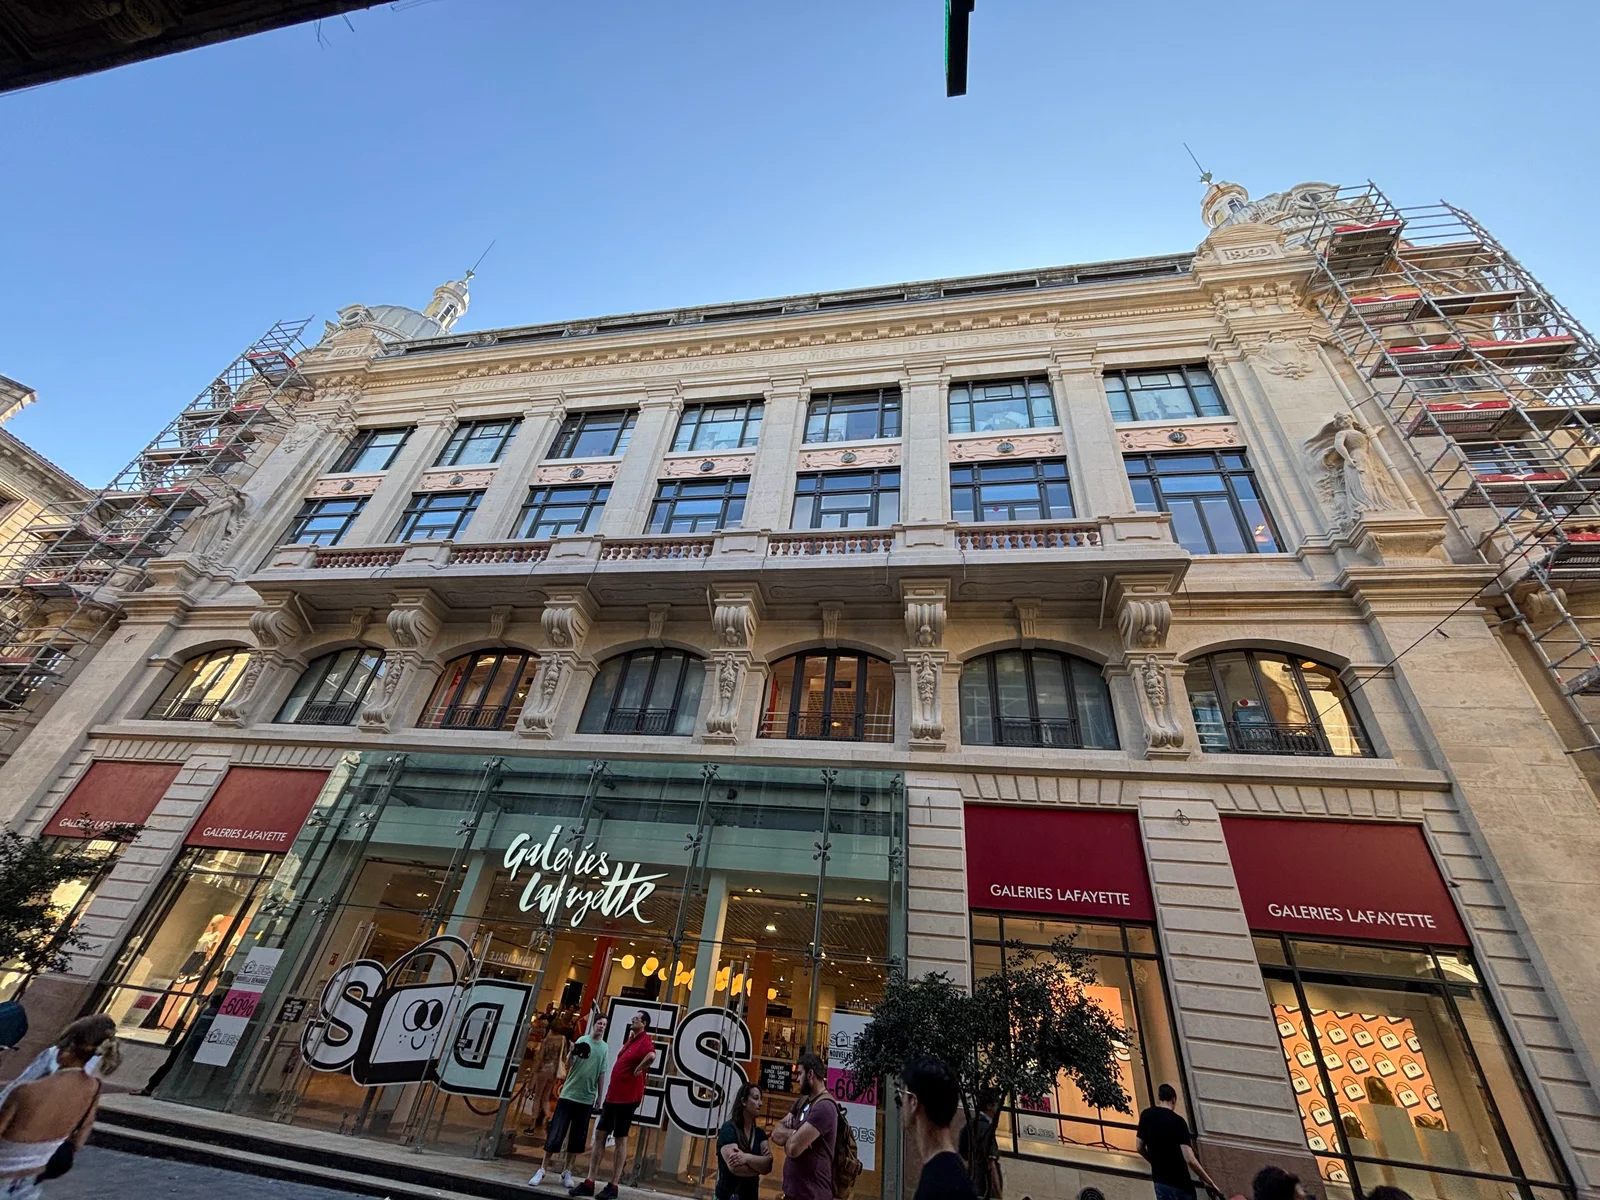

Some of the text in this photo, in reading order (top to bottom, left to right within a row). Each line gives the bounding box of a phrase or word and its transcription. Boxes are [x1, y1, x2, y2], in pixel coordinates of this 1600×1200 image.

[519, 372, 584, 386] ANONYME
[588, 368, 612, 380] DES
[620, 363, 676, 377] GRANDS
[681, 355, 756, 373] MAGASINS
[788, 347, 872, 362] COMMERCE
[202, 826, 288, 842] GALERIES LAFAYETTE
[503, 824, 609, 882] Galeries
[990, 883, 1131, 906] GALERIES LAFAYETTE
[1268, 903, 1437, 929] GALERIES LAFAYETTE
[222, 998, 255, 1017] -60%
